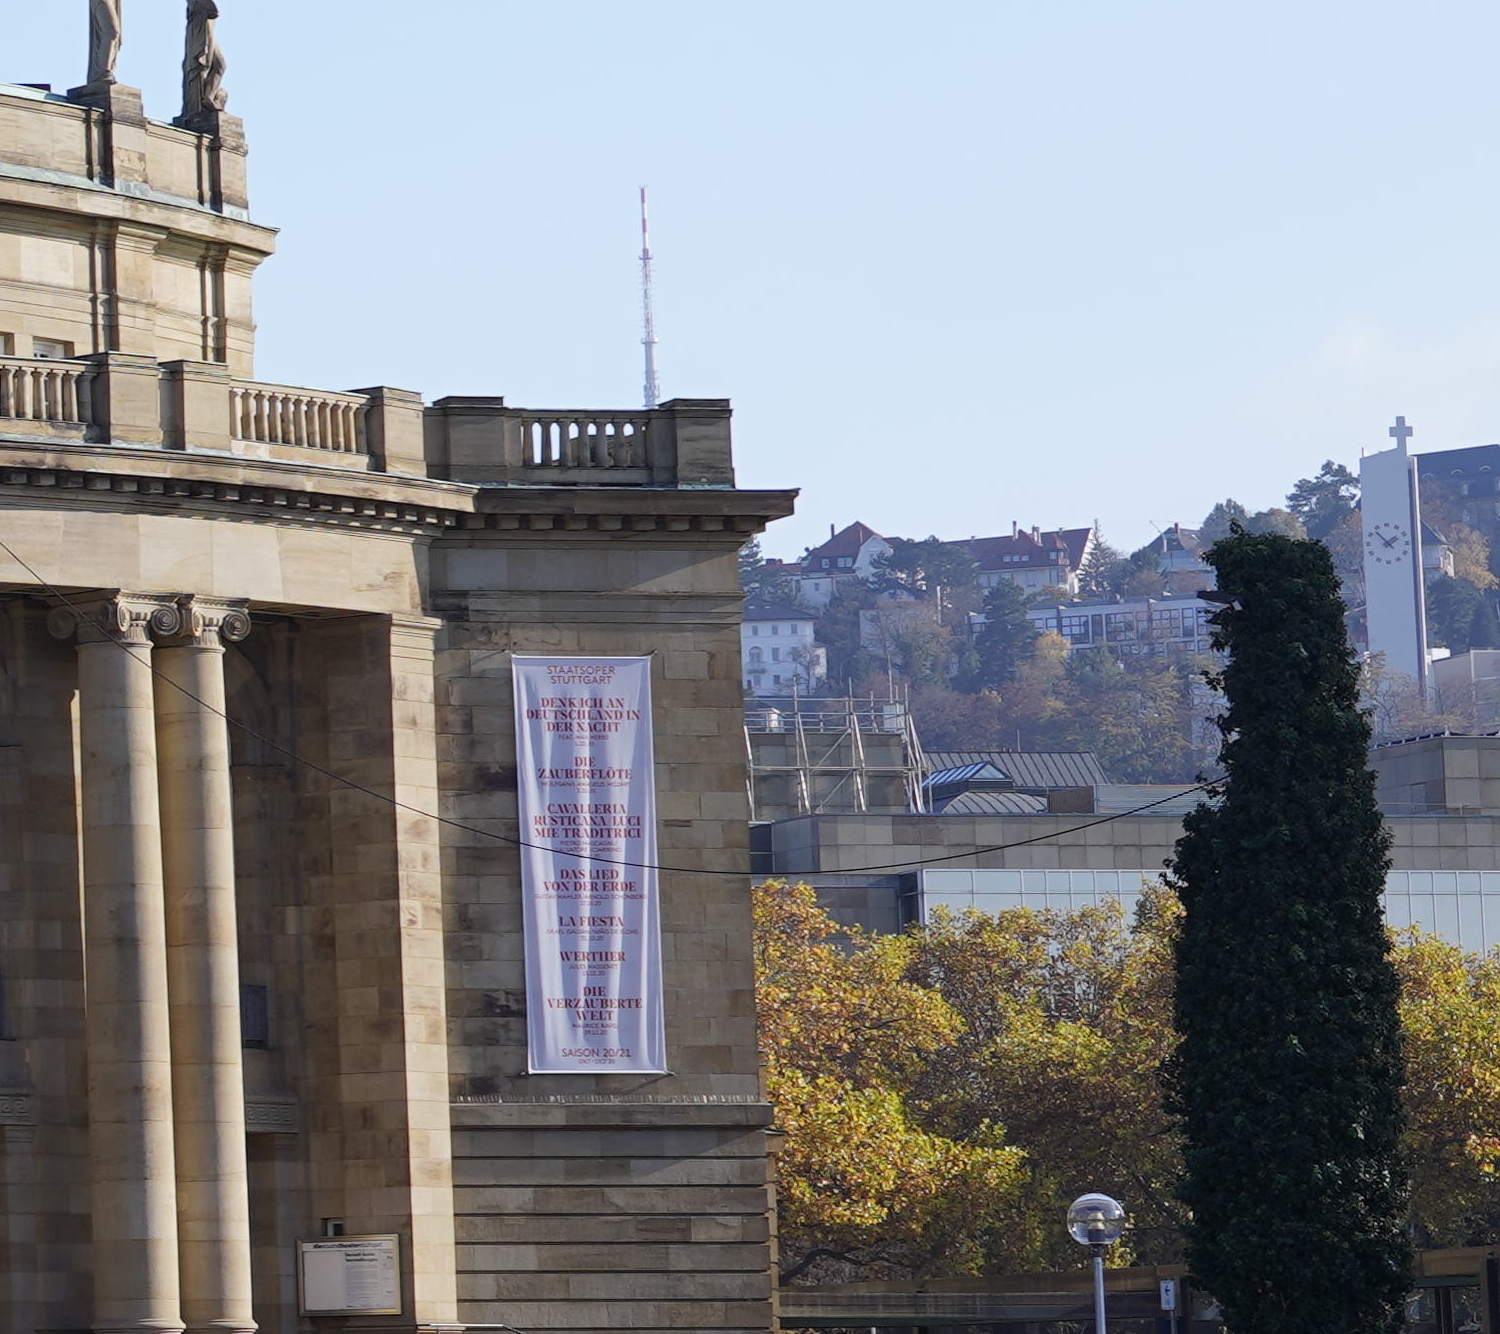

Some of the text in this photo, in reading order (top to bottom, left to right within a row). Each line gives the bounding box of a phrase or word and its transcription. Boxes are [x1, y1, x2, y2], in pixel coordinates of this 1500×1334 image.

[547, 666, 615, 675] STAATSOPER
[550, 675, 612, 685] STUTTGART
[540, 697, 625, 708] DENK ICH AN
[526, 709, 641, 720] DEUTSCHLAND IN
[546, 722, 620, 732] DER NACHT
[574, 757, 596, 767] DIE
[538, 767, 632, 779] ZAUBERFLÖTE
[547, 803, 626, 814] CAVALLERIA
[535, 828, 642, 838] MIE TRADITRICI
[560, 869, 619, 879] DAS LIED
[543, 881, 637, 892] VON DER ERDE
[559, 916, 624, 927] LA FIESTA
[560, 951, 626, 962] WERTHER
[583, 986, 606, 997] DIE
[547, 998, 643, 1009] VERZAUBERTE
[576, 1010, 614, 1021] WELT
[562, 1048, 632, 1058] SAISON 20/21
